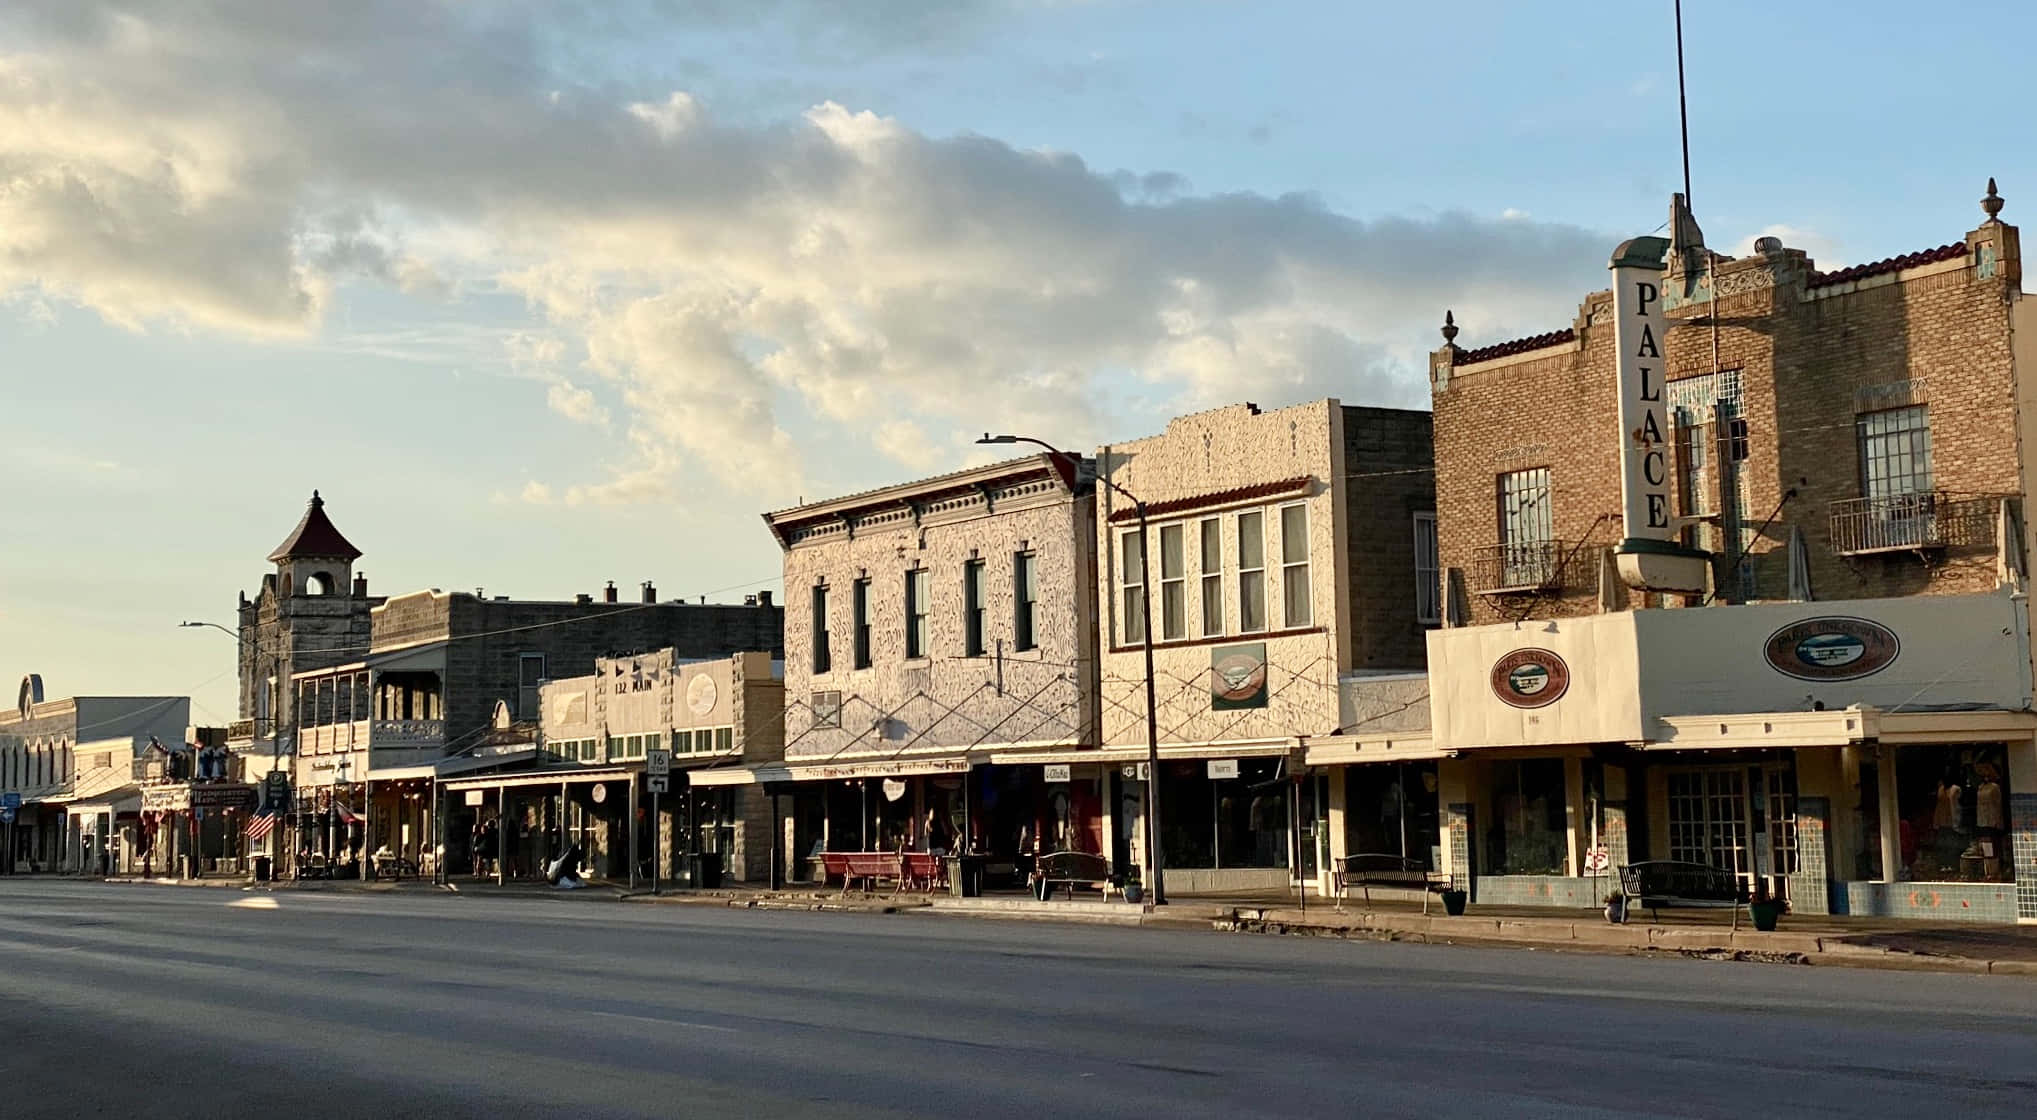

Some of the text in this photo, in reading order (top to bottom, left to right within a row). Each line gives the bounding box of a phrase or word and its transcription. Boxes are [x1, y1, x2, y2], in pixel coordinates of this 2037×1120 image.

[1636, 282, 1668, 528] PALACE
[615, 679, 652, 695] 132 MAIN
[653, 753, 665, 766] 16
